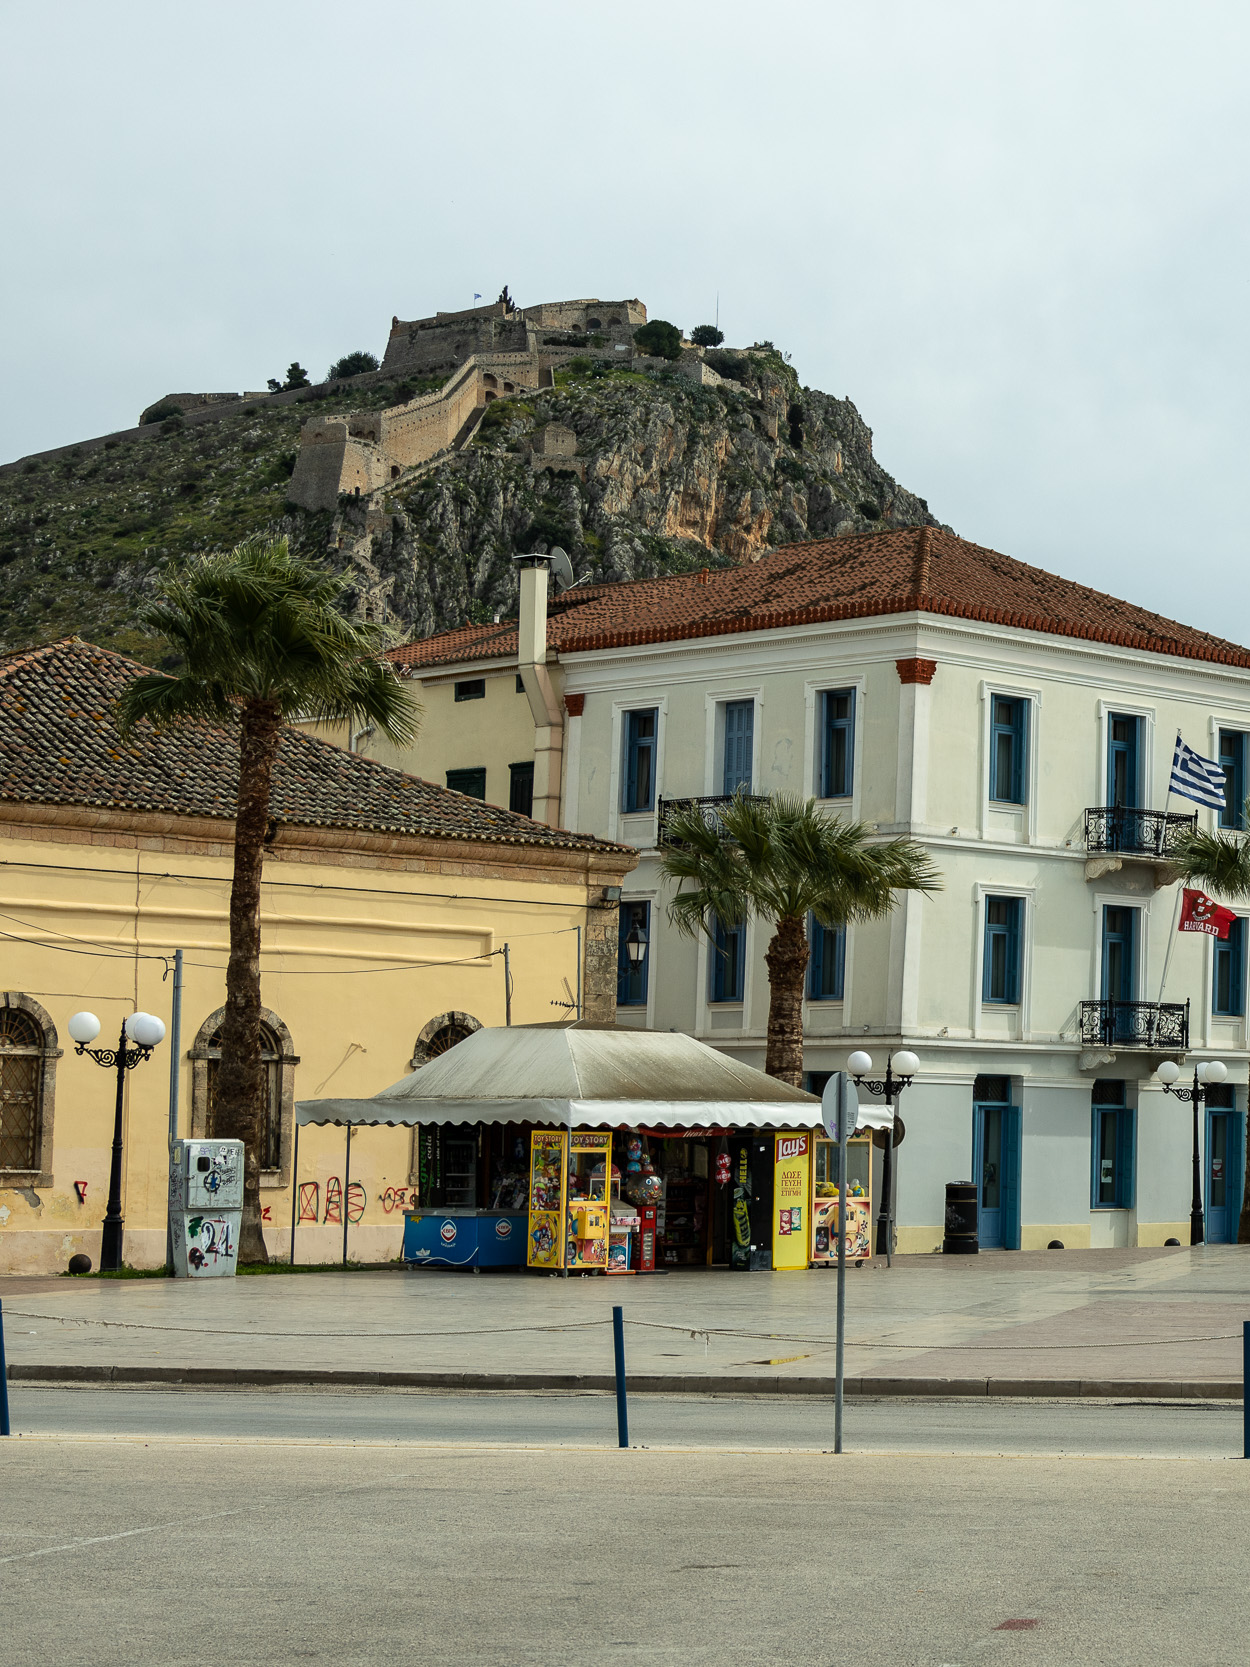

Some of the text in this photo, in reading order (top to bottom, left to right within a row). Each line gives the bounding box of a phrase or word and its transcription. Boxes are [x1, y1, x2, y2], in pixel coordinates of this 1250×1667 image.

[1184, 920, 1219, 935] HARVARD
[545, 1135, 562, 1143] STORY
[585, 1136, 608, 1144] STORY
[778, 1136, 806, 1161] Lay's
[781, 1170, 802, 1179] ΔΩΣΕ
